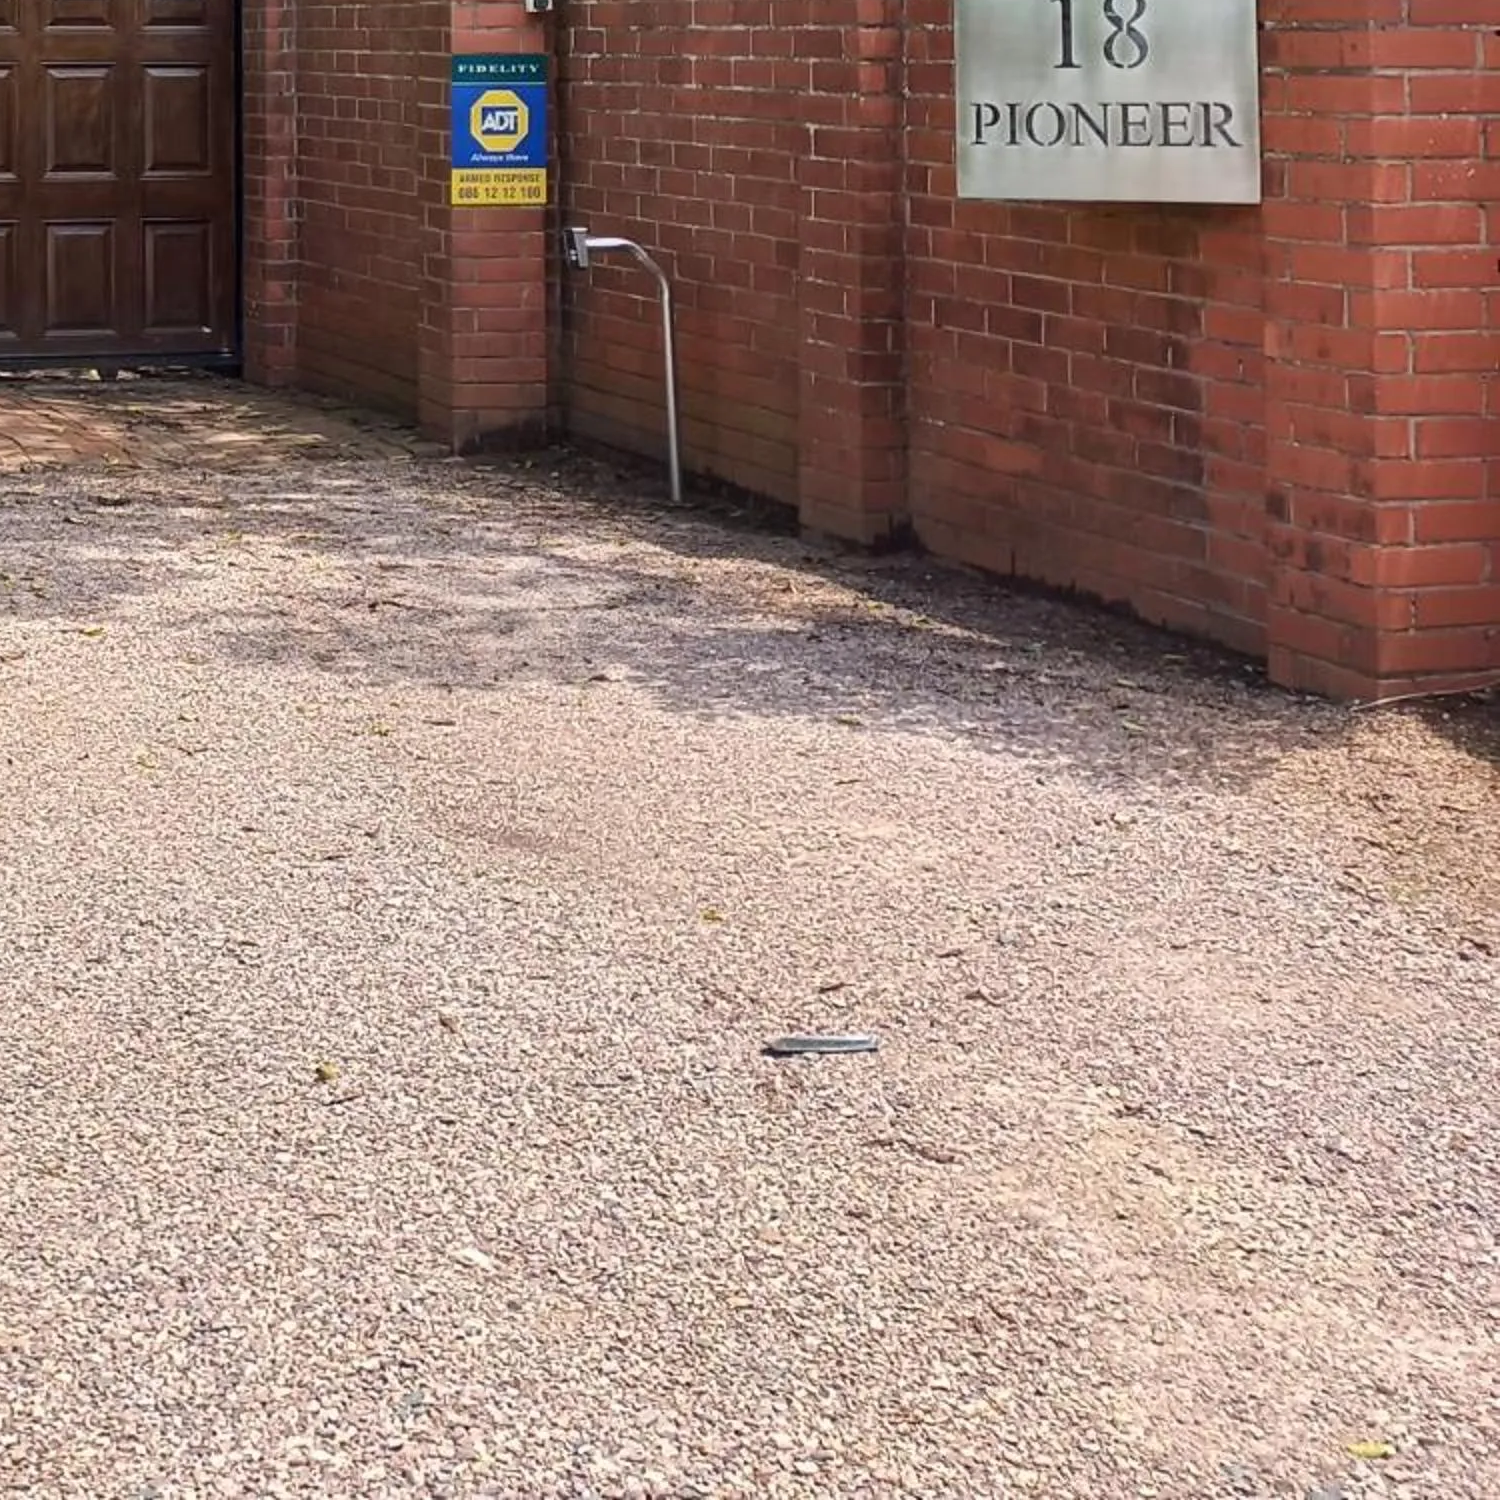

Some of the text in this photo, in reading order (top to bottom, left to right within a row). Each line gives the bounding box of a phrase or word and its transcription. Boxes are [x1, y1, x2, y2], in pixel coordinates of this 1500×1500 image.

[457, 64, 540, 73] FIDELITY
[482, 111, 518, 132] ADT
[970, 102, 1243, 147] PIONEER
